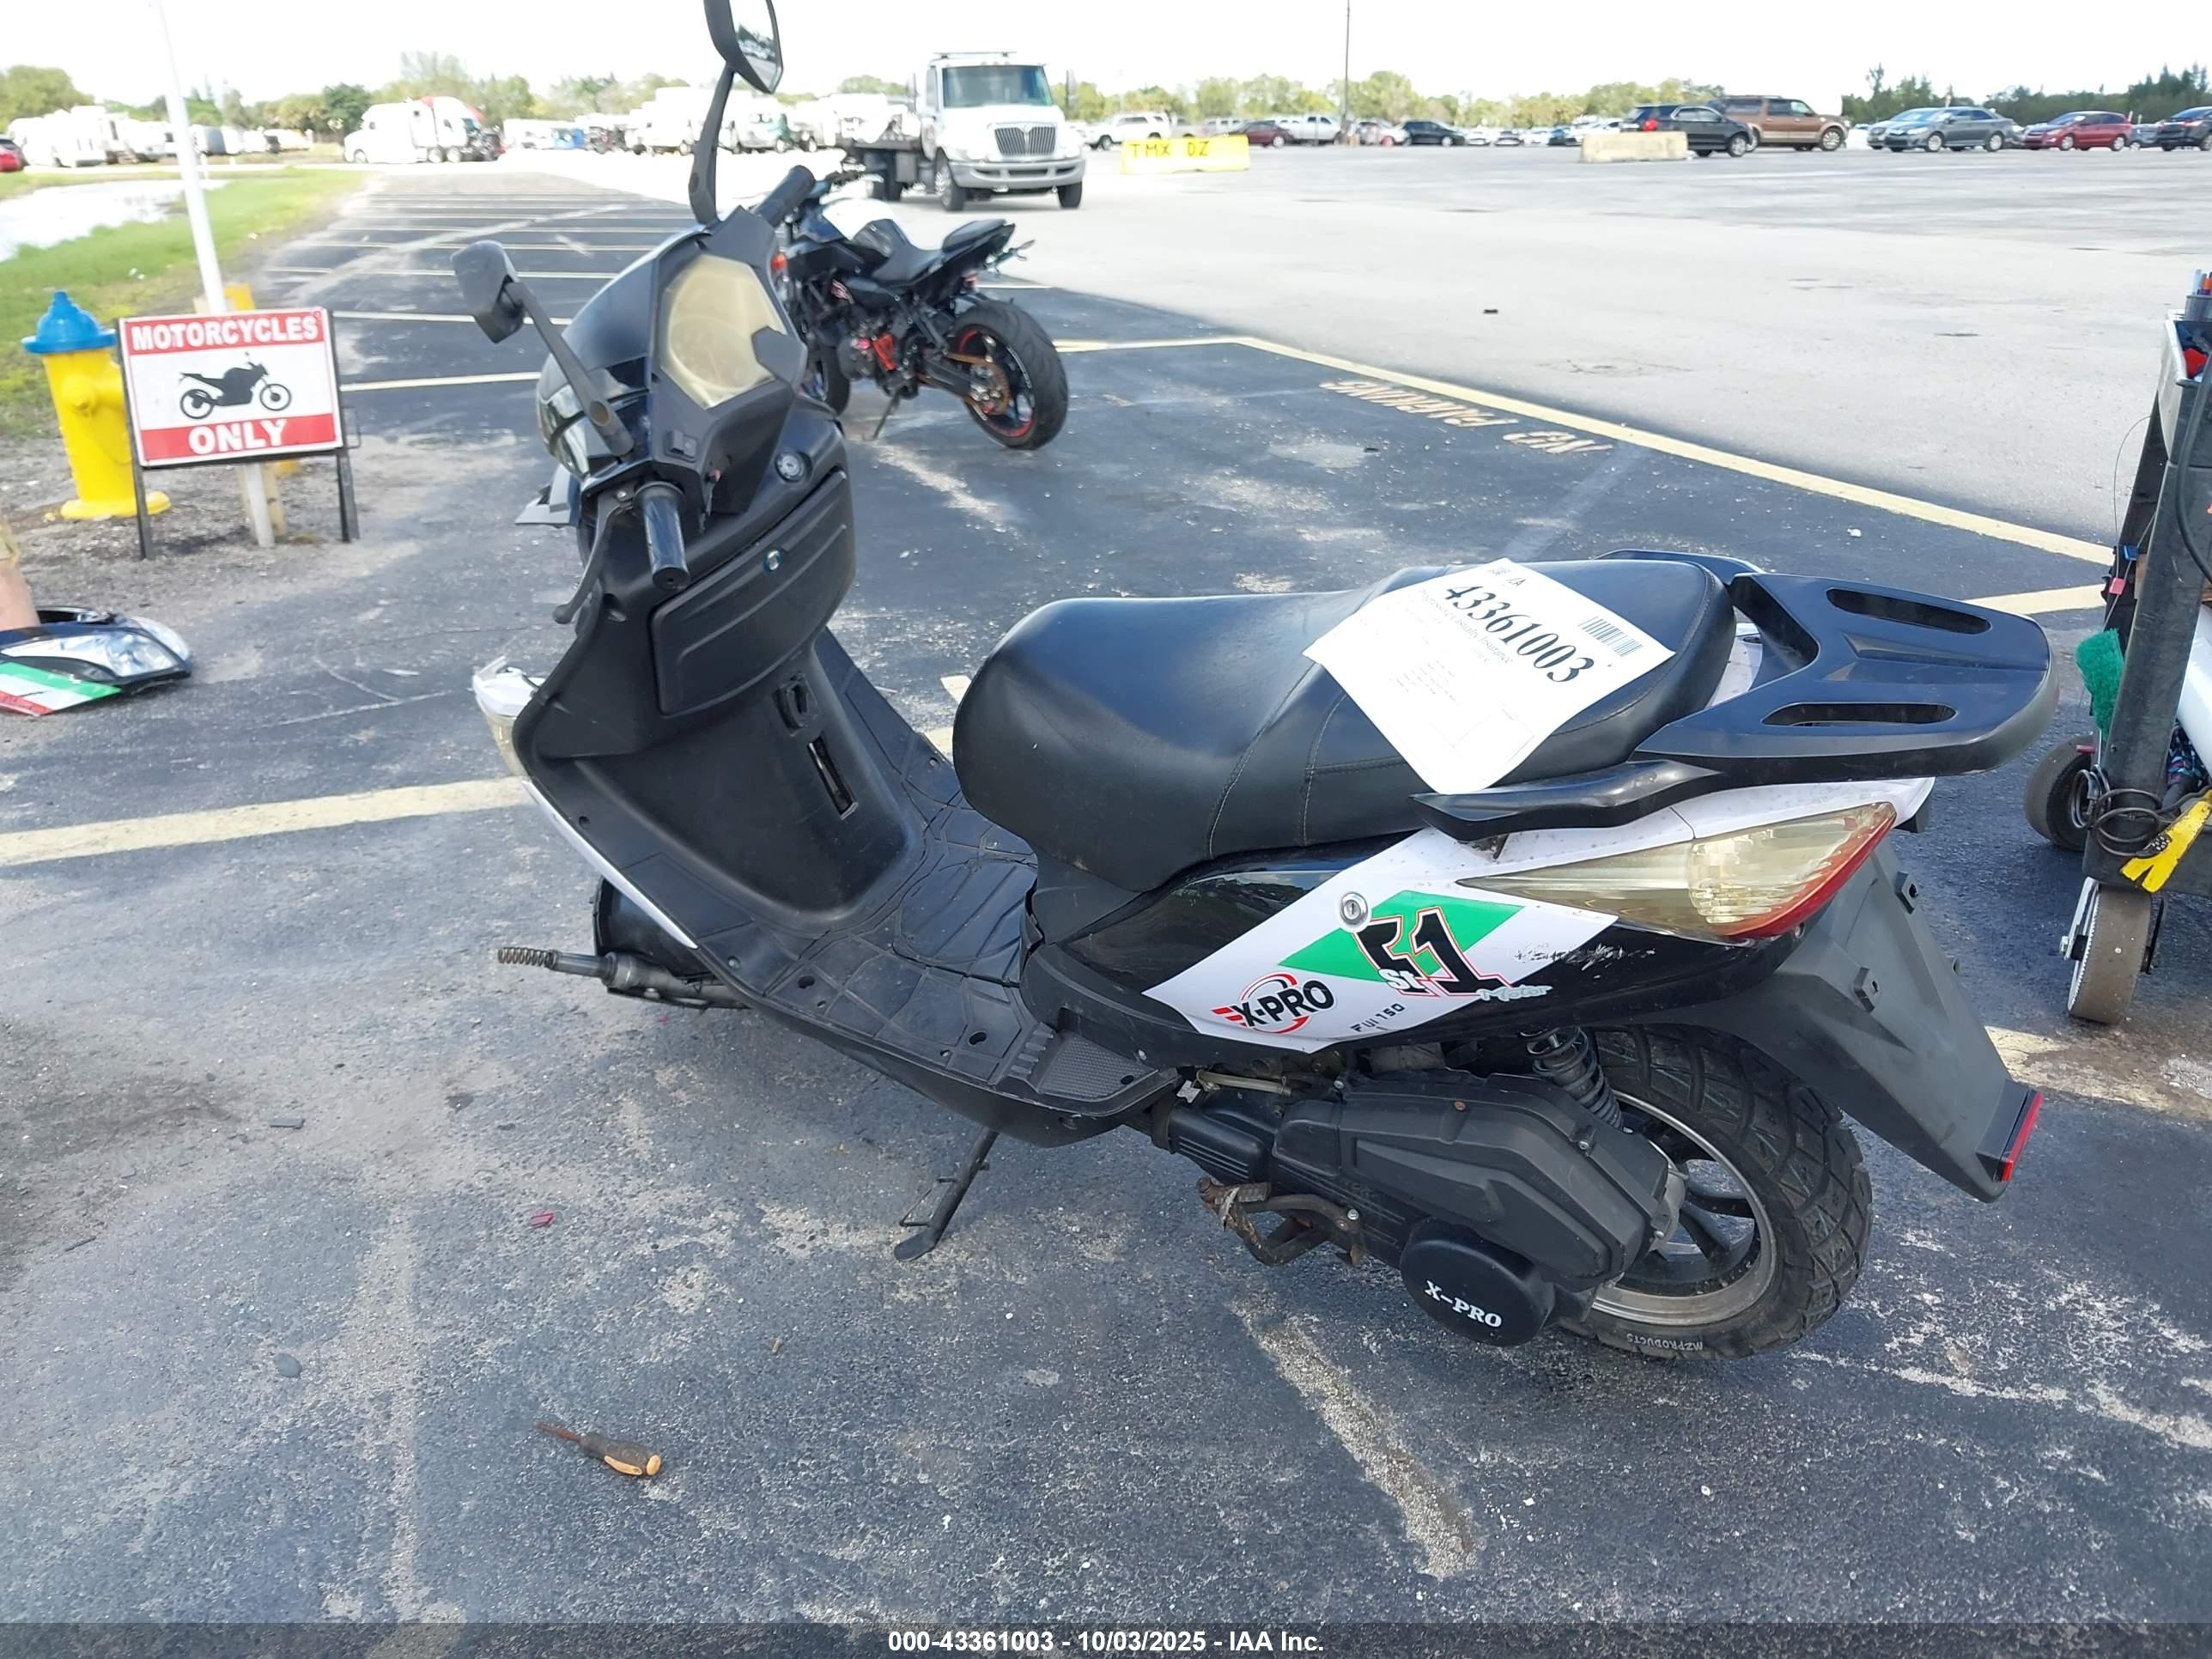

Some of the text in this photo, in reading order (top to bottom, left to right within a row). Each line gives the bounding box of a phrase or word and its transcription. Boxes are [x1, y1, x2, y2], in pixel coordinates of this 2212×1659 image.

[131, 315, 319, 351] MOTORCYCLES
[188, 418, 288, 455] ONLY
[1444, 586, 1595, 683] 43361003
[1231, 980, 1335, 1027] X-PRO
[1374, 1003, 1406, 1020] 150
[1476, 984, 1553, 1002] Motor
[1425, 1279, 1503, 1328] X-PRO
